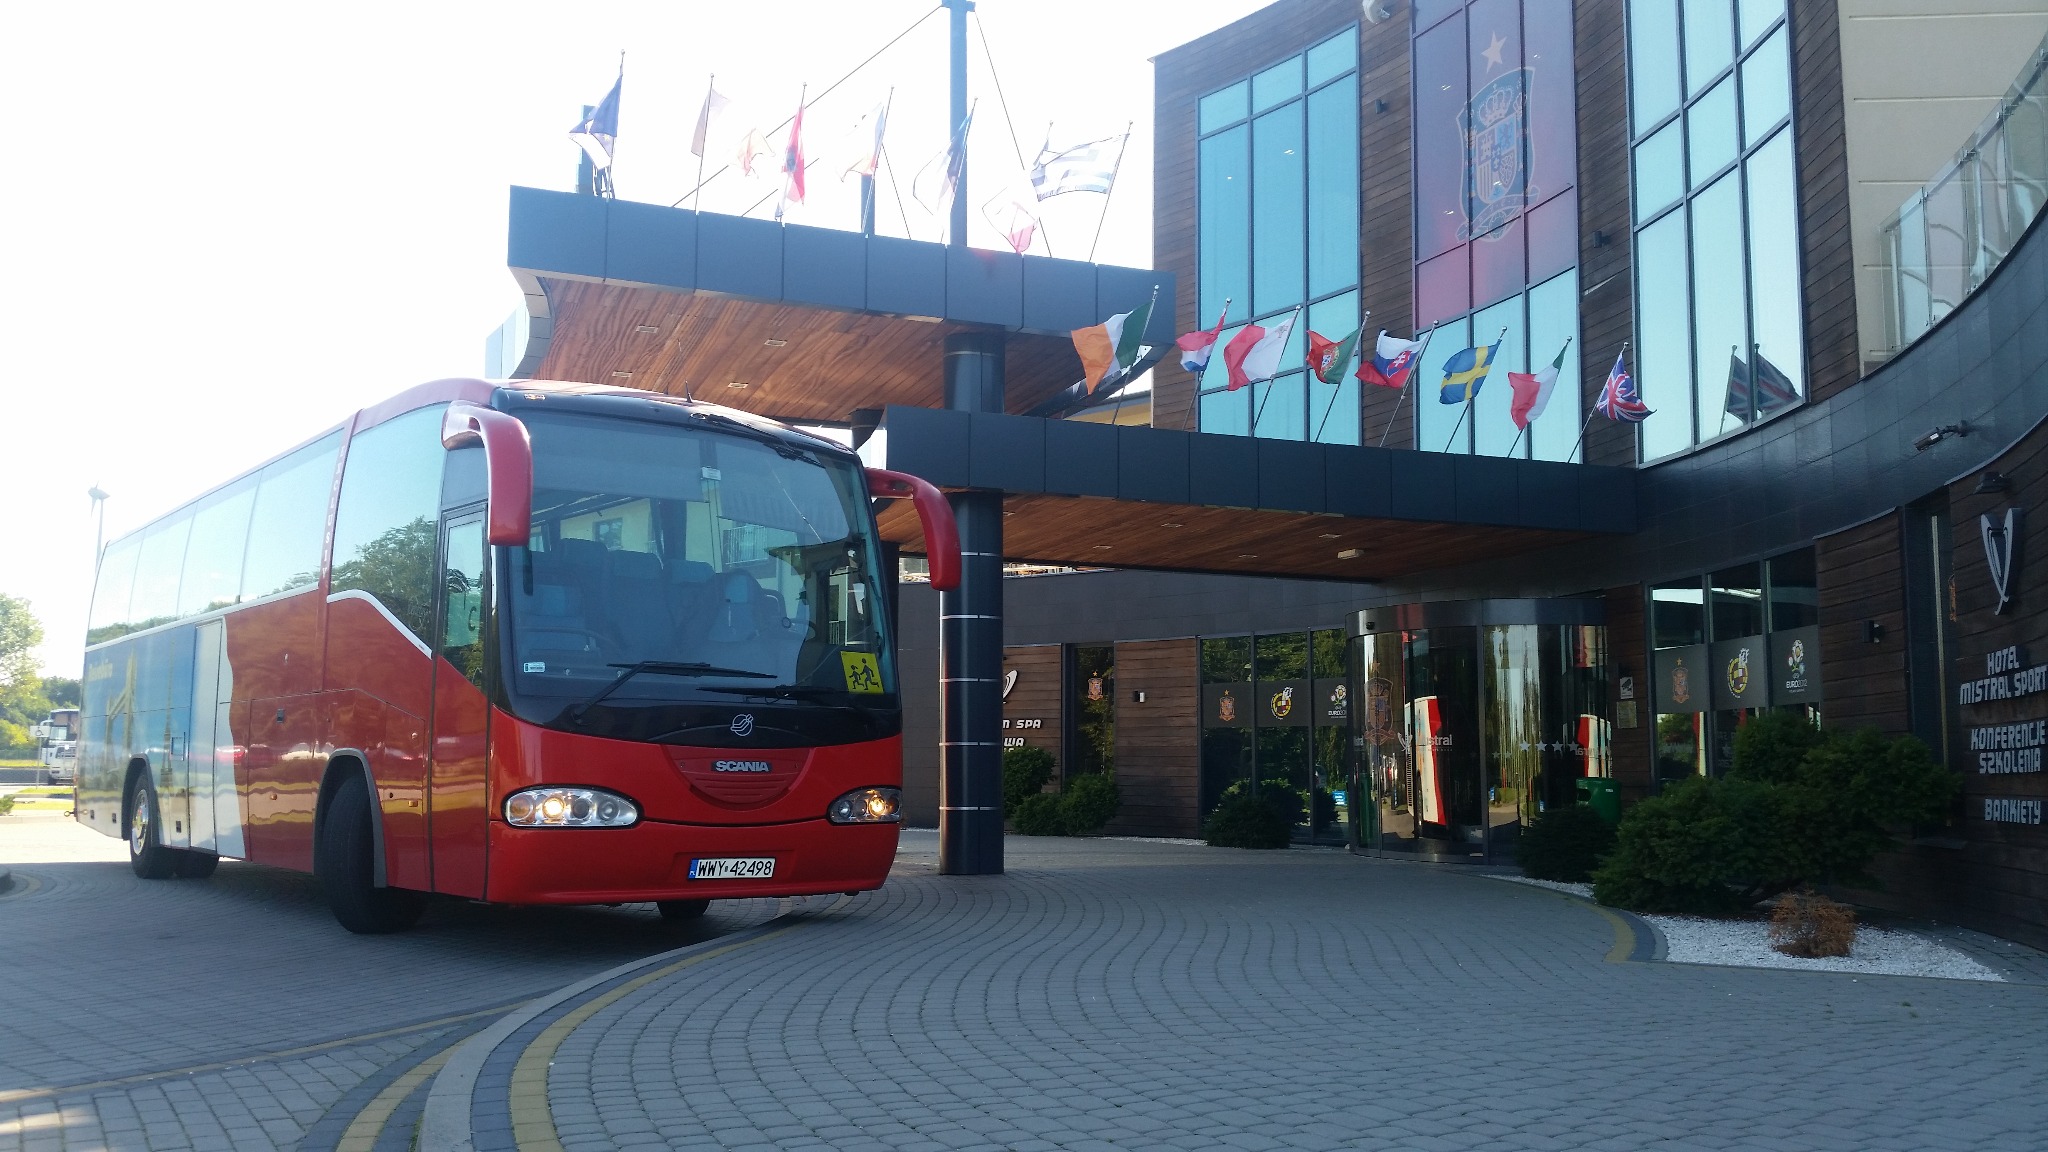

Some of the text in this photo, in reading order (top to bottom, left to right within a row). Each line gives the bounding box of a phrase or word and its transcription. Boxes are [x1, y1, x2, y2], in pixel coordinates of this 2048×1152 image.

[1987, 645, 2020, 676] HOTEL
[1960, 665, 2048, 705] MISTRAL SPORT
[1015, 719, 1042, 729] SPA
[1970, 720, 2046, 750] KONFERENCJE
[715, 760, 770, 772] SCANIA
[1979, 748, 2041, 774] SZKOLENIA
[1984, 798, 2041, 825] BANKIETY
[729, 860, 773, 877] 42498
